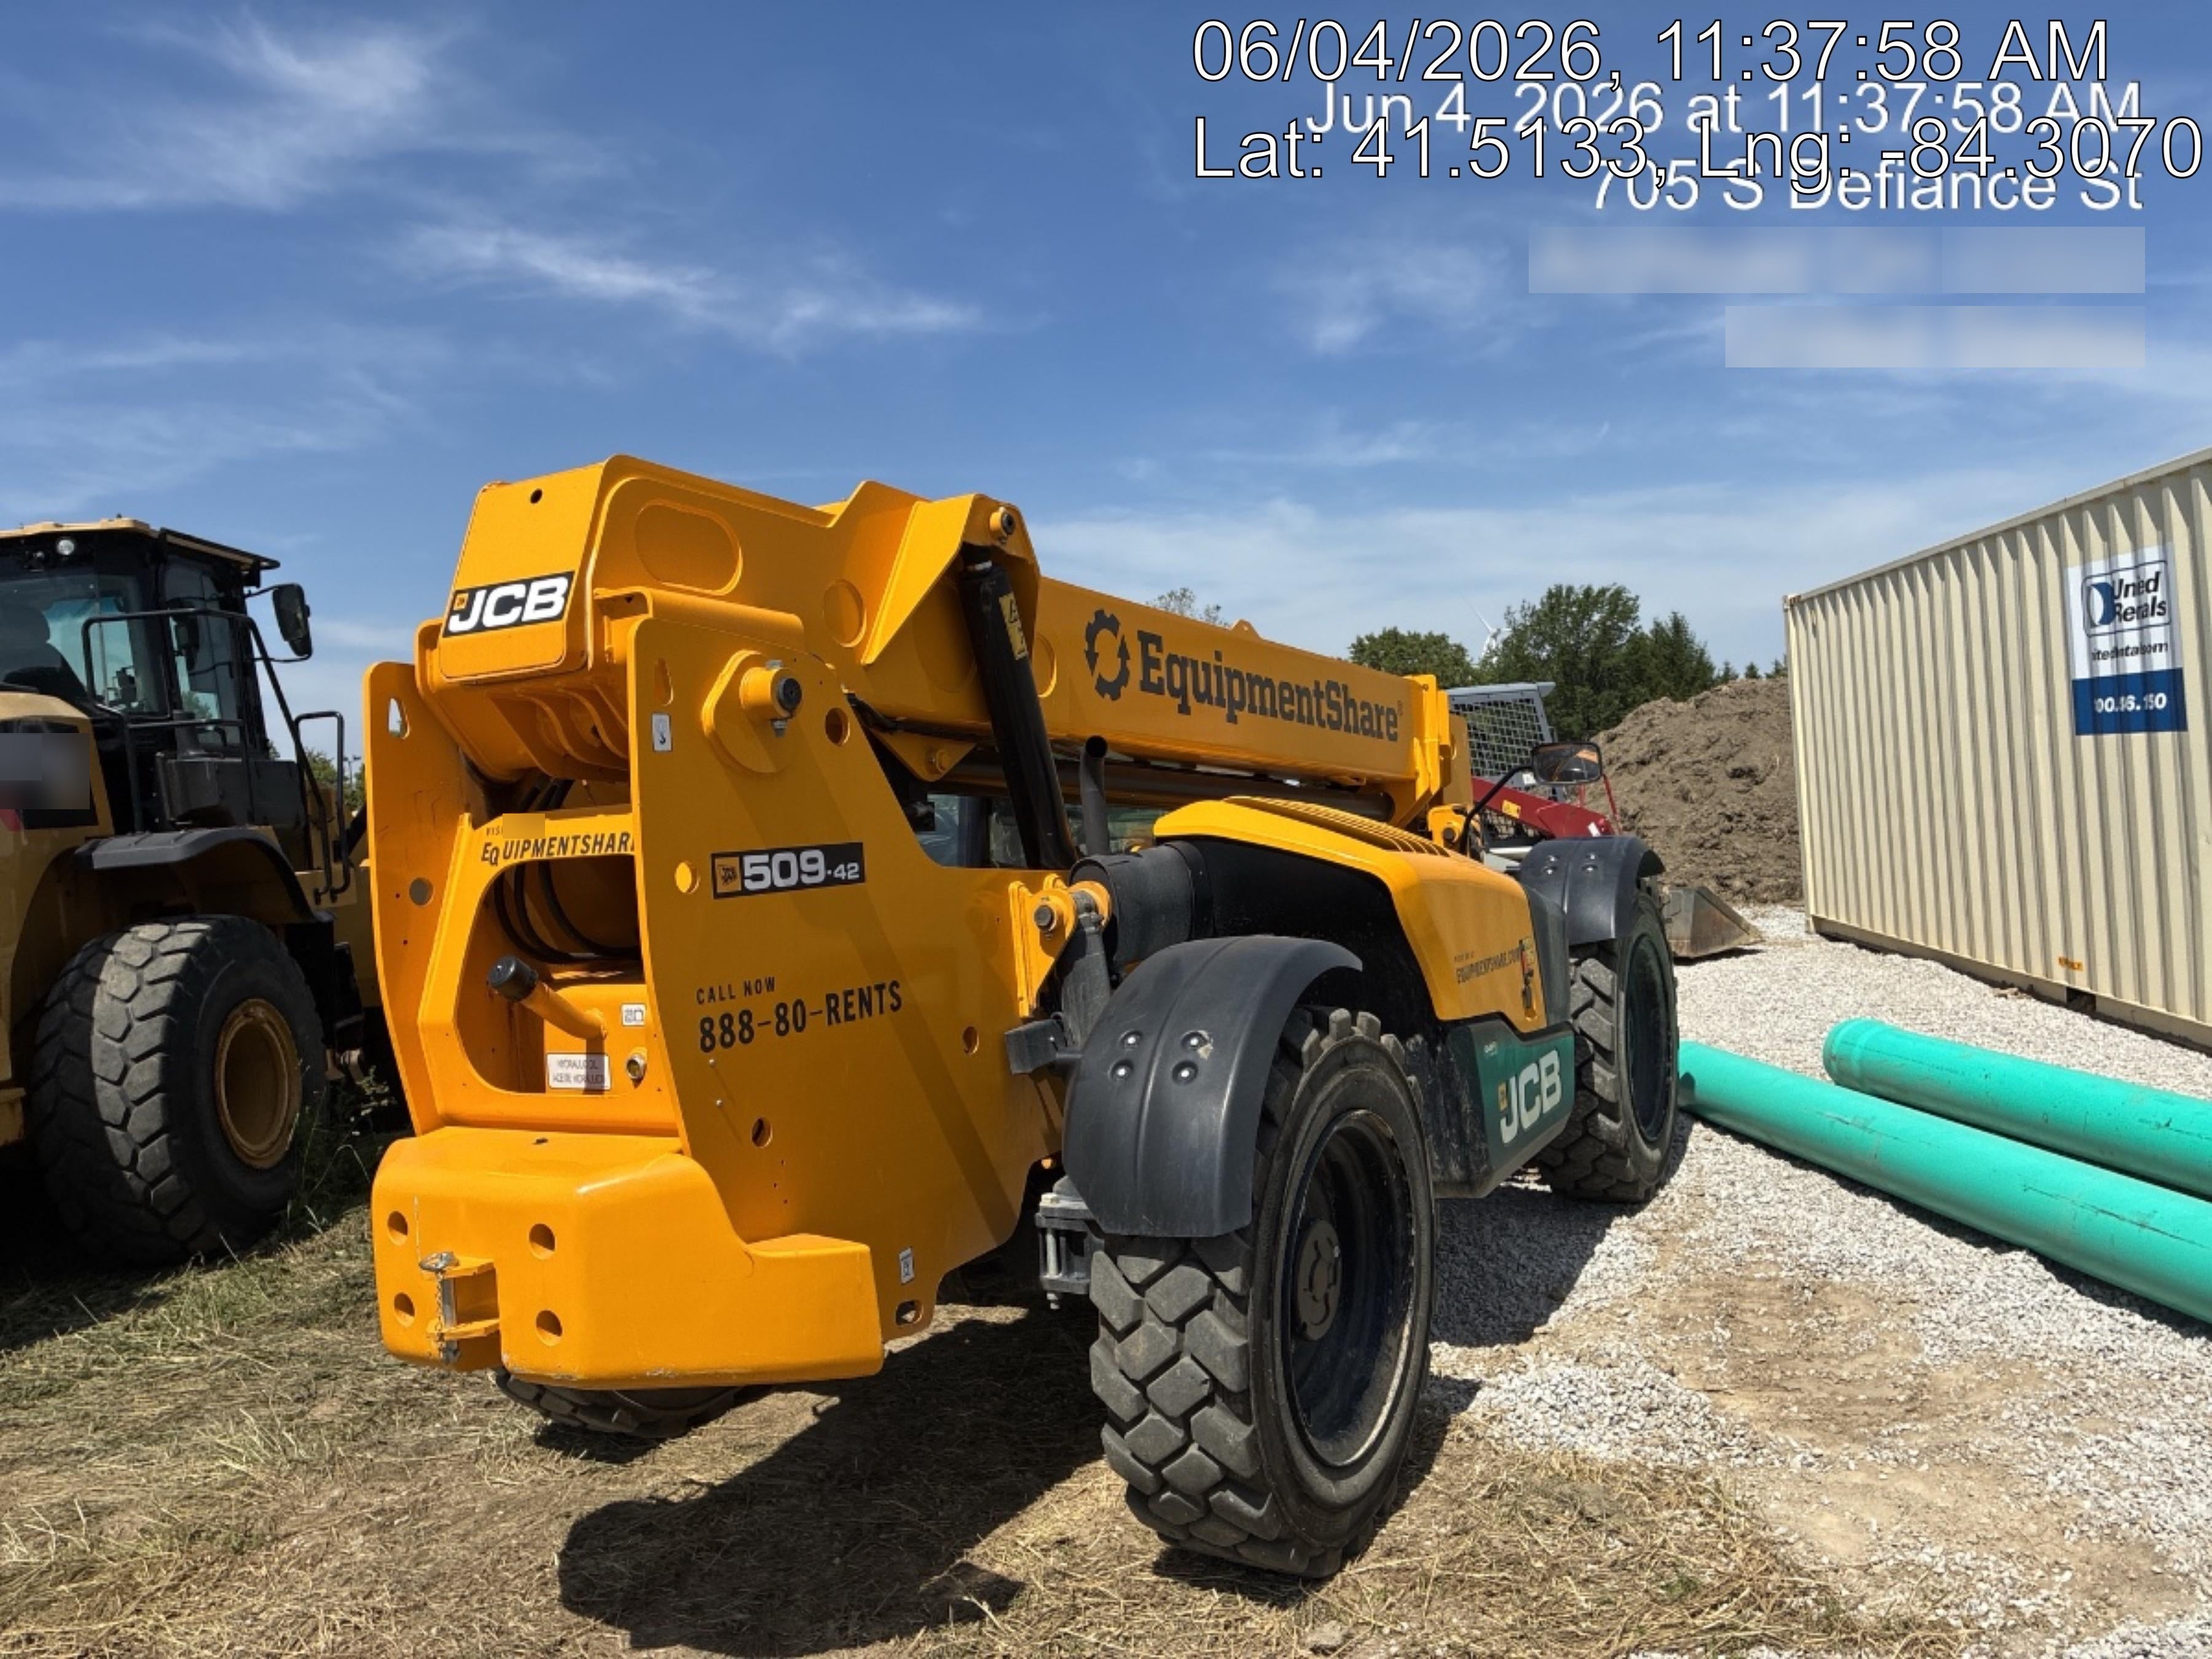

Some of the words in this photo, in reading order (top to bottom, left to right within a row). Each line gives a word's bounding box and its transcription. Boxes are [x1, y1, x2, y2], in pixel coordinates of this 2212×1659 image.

[448, 576, 568, 633] JCB
[1137, 630, 1398, 742] EquipmentShare
[480, 831, 635, 866] EQUIPMENTSHAR
[696, 984, 736, 1005] CALL
[743, 976, 775, 997] NOW
[699, 980, 902, 1053] 888-80-RENTS
[1499, 1049, 1562, 1144] JCB
